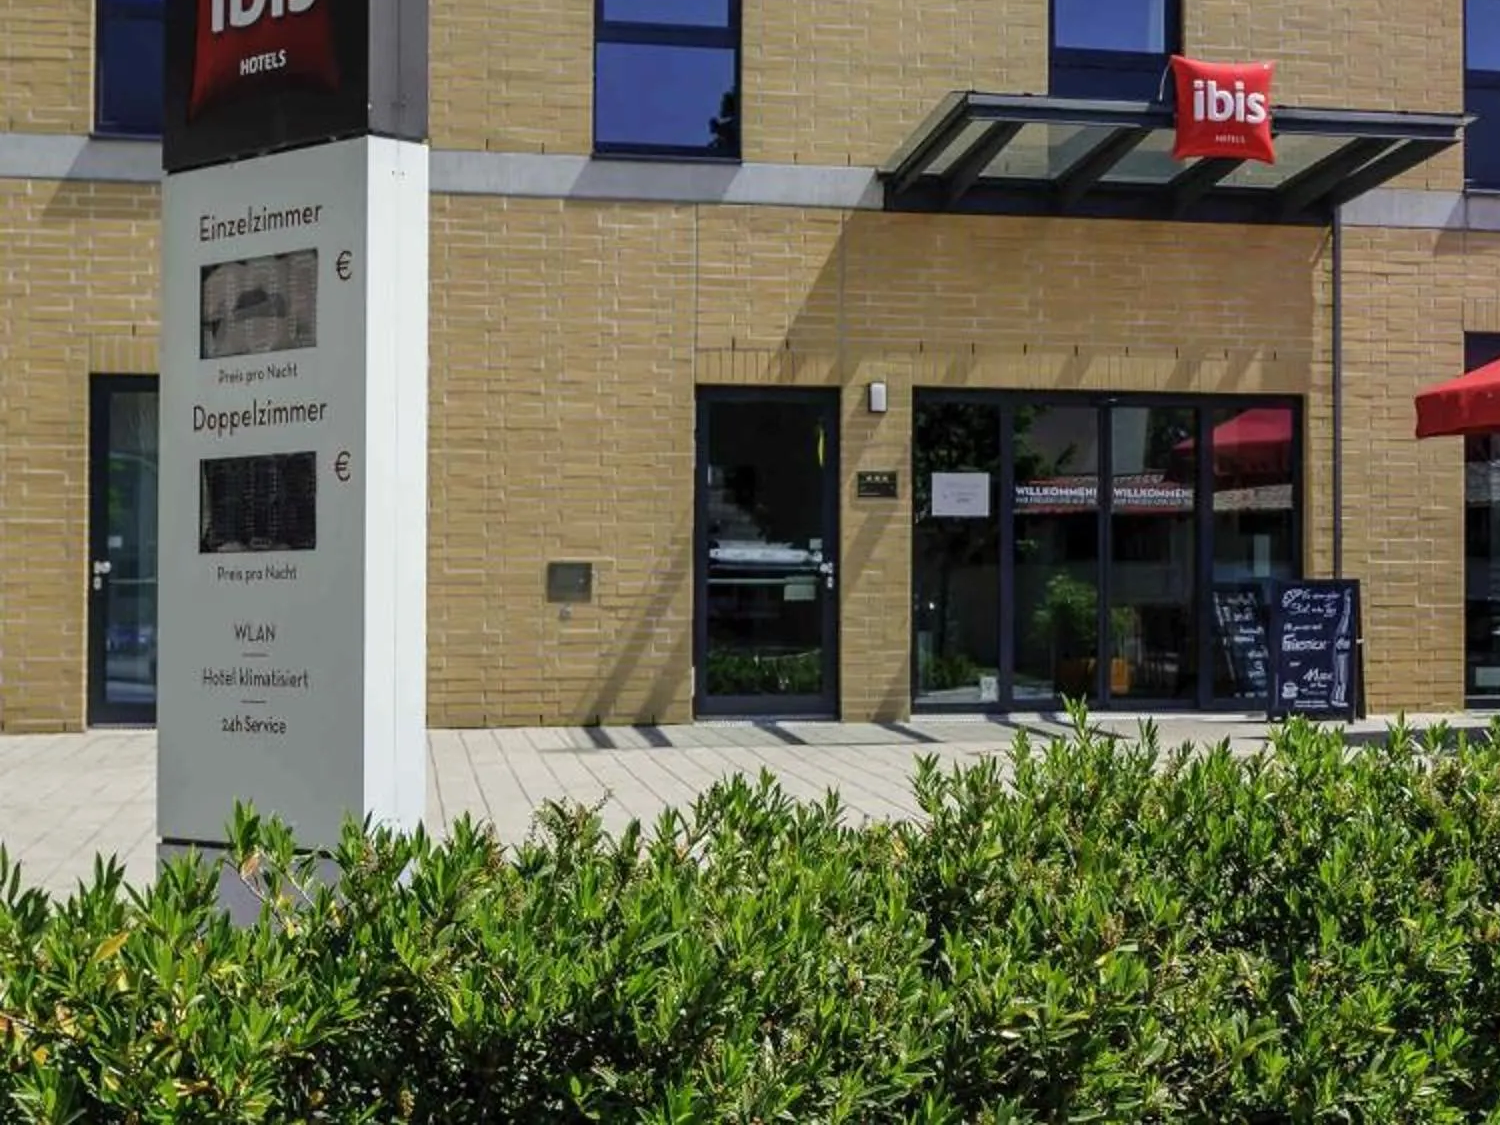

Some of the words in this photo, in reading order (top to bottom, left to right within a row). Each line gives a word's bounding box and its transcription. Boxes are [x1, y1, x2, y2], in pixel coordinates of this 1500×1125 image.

[239, 49, 287, 77] HOTELS
[1193, 79, 1268, 125] ibis
[199, 204, 324, 243] Einzelzimmer
[217, 368, 244, 384] Preis
[245, 368, 266, 386] pro
[267, 362, 299, 378] Nacht
[192, 398, 328, 437] Doppelzimmer
[216, 565, 244, 582] Preis
[244, 569, 264, 585] pro
[265, 564, 298, 581] Nacht
[234, 623, 276, 643] WLAN
[202, 667, 237, 687] Hotel
[239, 667, 310, 690] klimatisiert
[221, 714, 243, 733] 24h
[244, 715, 289, 736] Service
